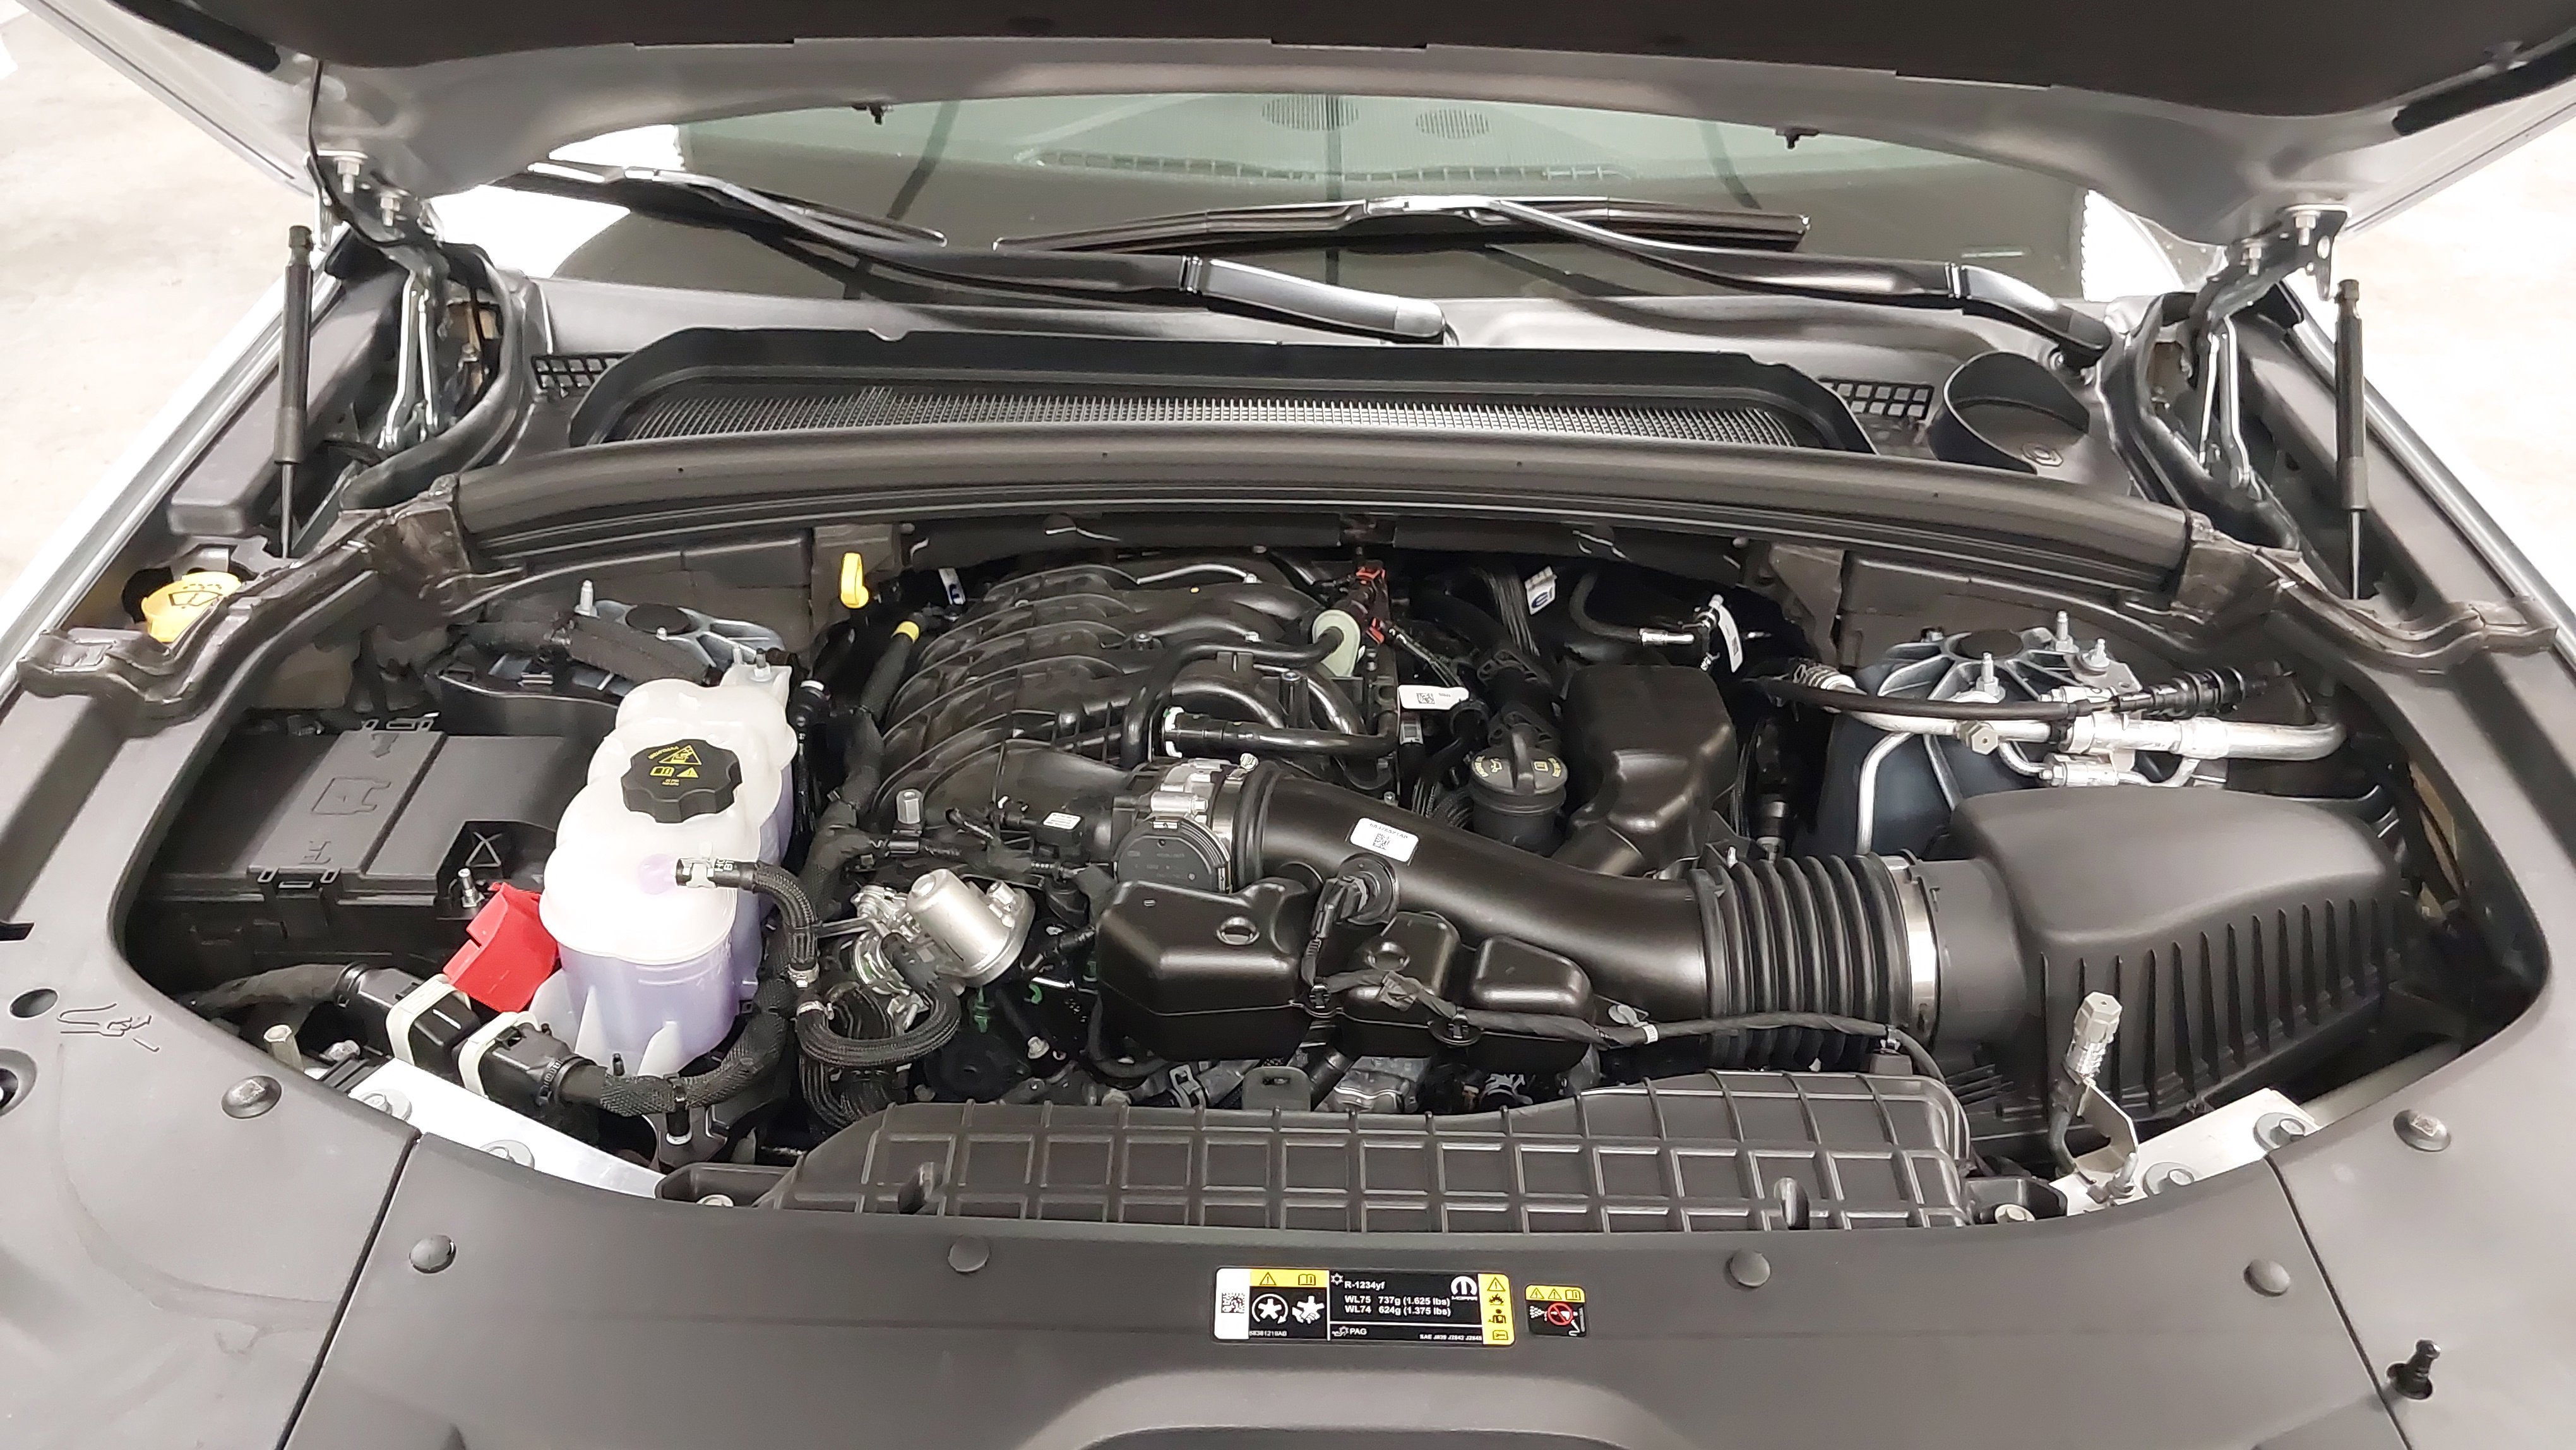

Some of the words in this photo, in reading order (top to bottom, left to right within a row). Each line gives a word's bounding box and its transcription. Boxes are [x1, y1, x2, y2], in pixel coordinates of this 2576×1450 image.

[1344, 1281, 1385, 1291] R-1234yf
[1344, 1295, 1371, 1303] WL75
[1378, 1296, 1401, 1305] 737g
[1403, 1296, 1431, 1306] (1.625
[1433, 1297, 1450, 1307] lbs)
[1344, 1305, 1372, 1314] WL74
[1378, 1305, 1401, 1315] 624g
[1403, 1306, 1431, 1316] (1.375
[1433, 1307, 1452, 1317] lbs)
[1349, 1327, 1368, 1336] PAG
